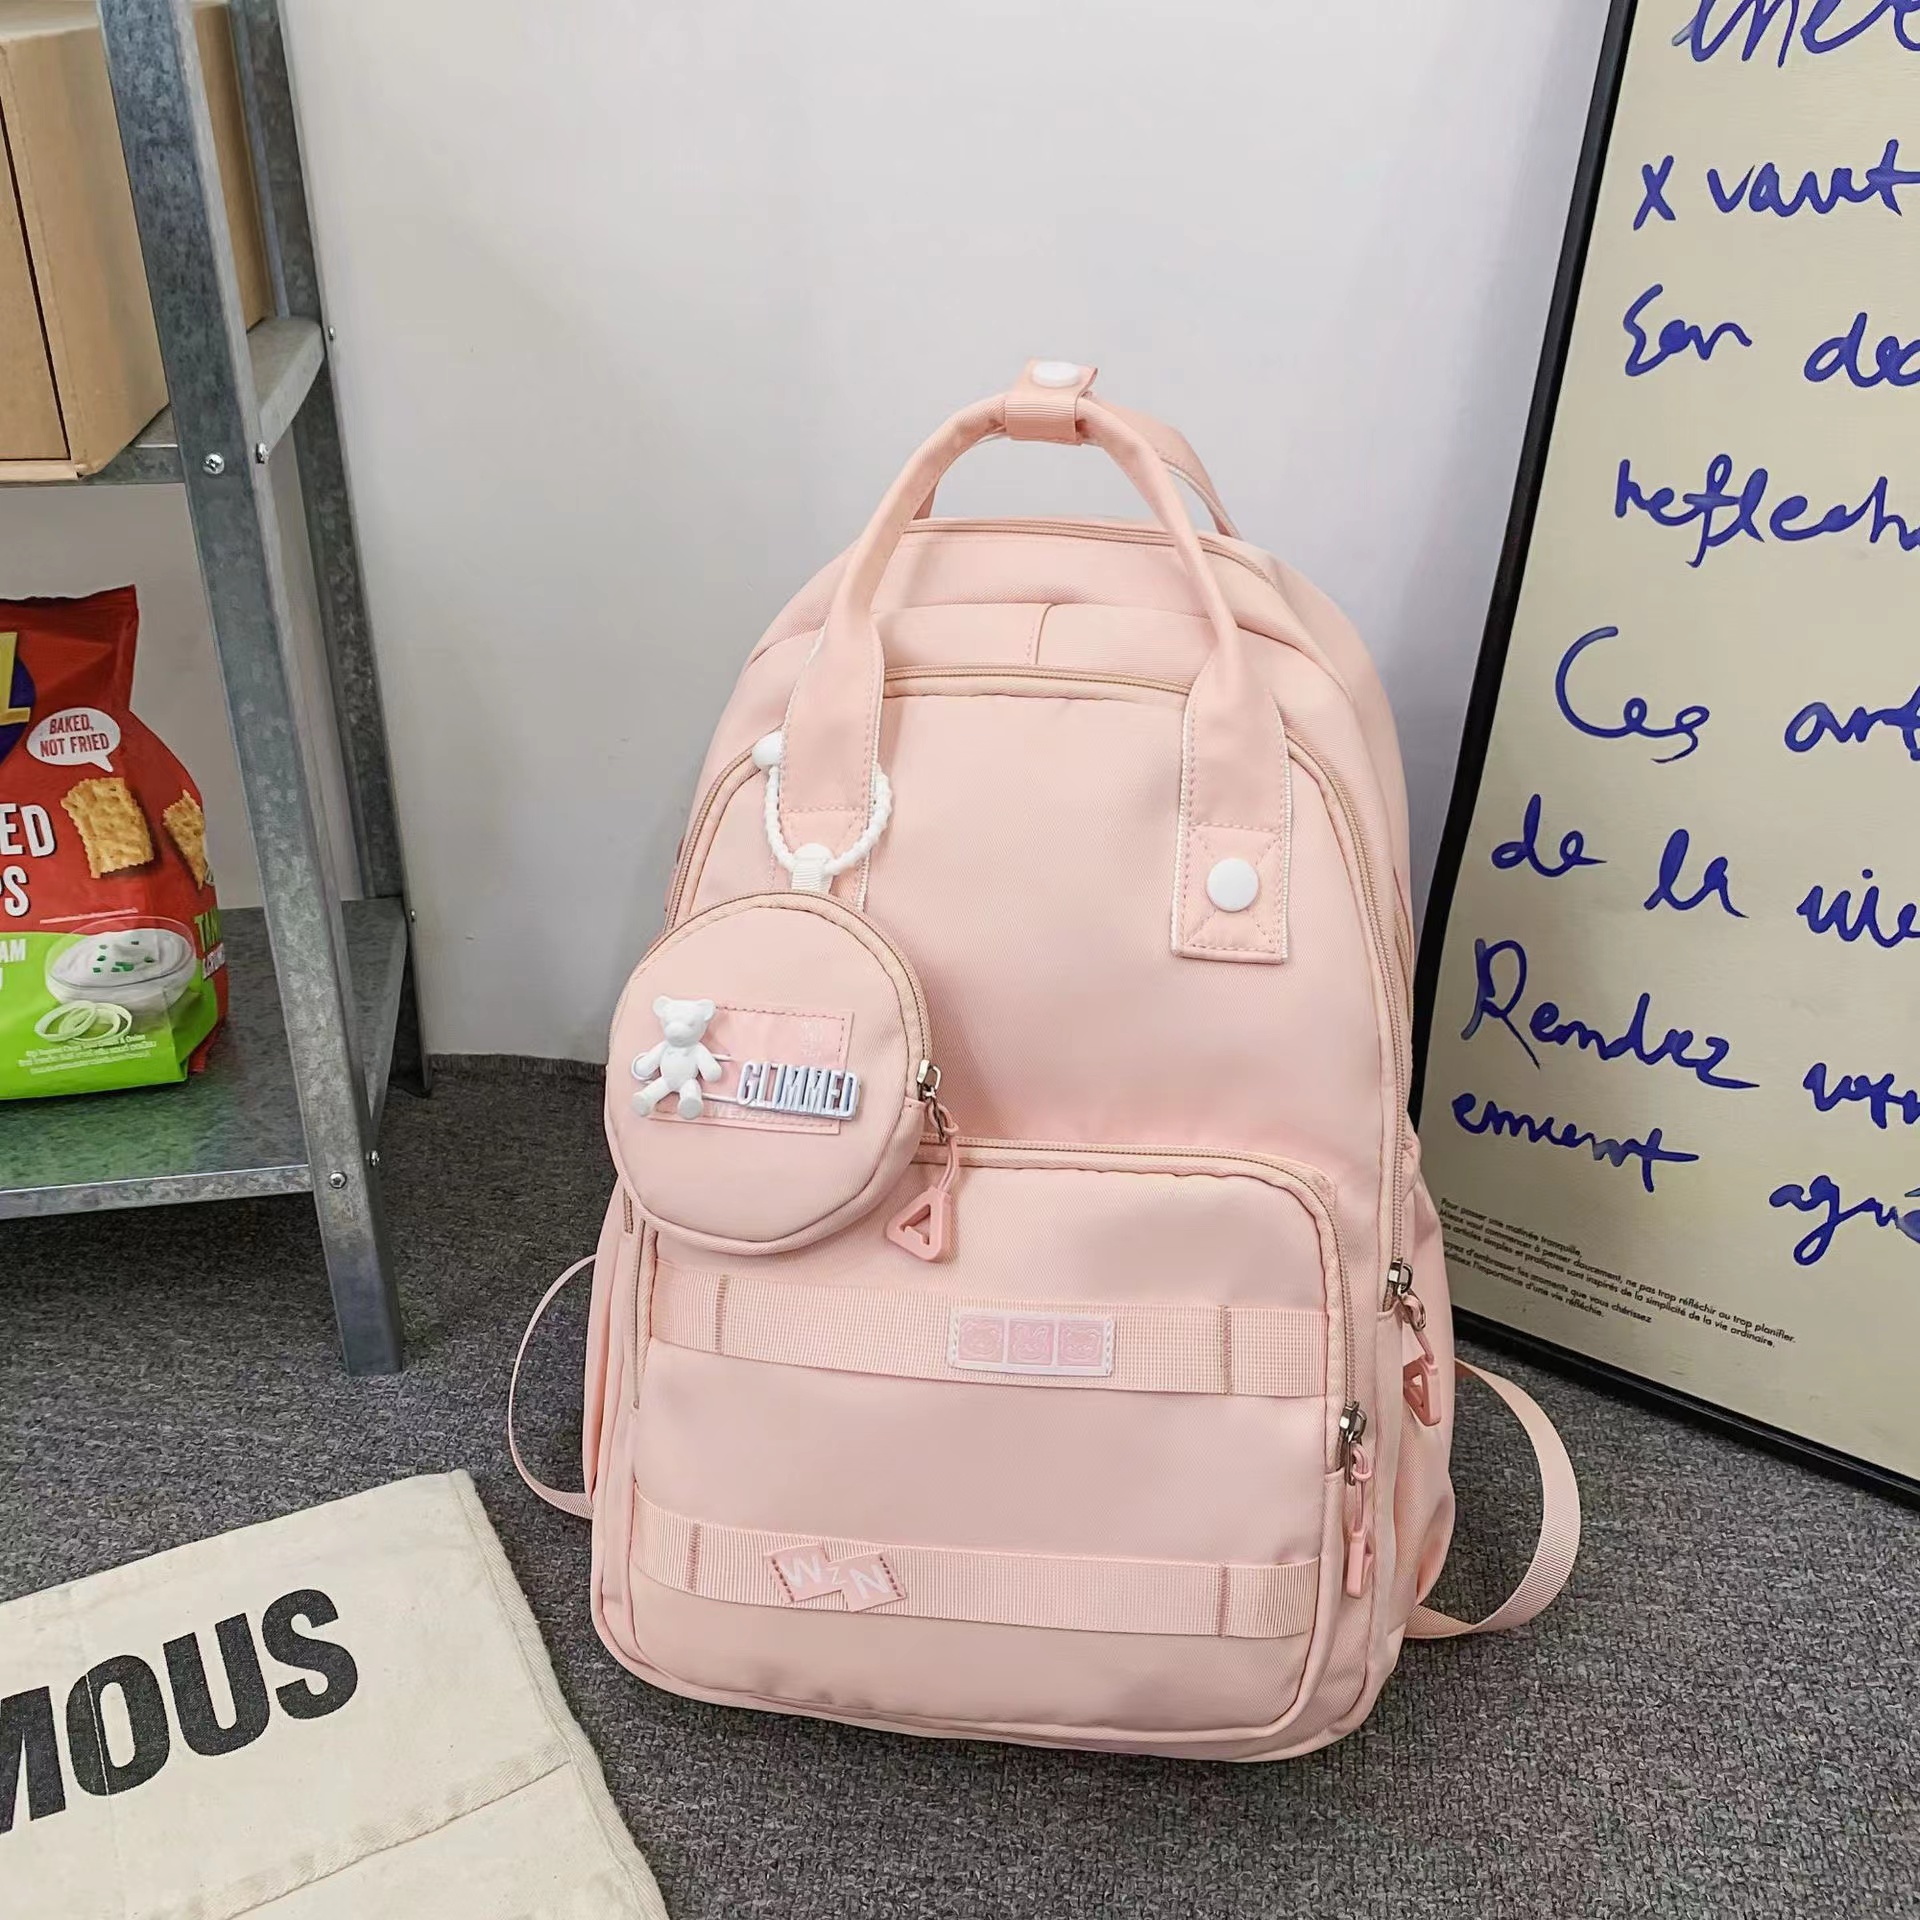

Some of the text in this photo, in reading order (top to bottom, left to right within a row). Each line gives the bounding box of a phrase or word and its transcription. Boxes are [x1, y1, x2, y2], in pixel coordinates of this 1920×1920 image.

[49, 714, 94, 734] BAKED,
[40, 733, 109, 757] NOT FRIED
[1492, 794, 1607, 878] de
[1550, 1291, 1564, 1302] vie
[1570, 1289, 1588, 1300] que
[1589, 1295, 1609, 1308] vous
[1572, 1258, 1623, 1284] doucement,
[1625, 1279, 1638, 1288] ne
[1637, 1283, 1656, 1295] pas
[1657, 1288, 1677, 1303] trop
[1732, 1315, 1753, 1332] trop
[1619, 1287, 1633, 1297] de
[1634, 1290, 1644, 1302] la
[1688, 1310, 1701, 1322] de
[1702, 1314, 1712, 1326] la
[1714, 1320, 1728, 1331] vie
